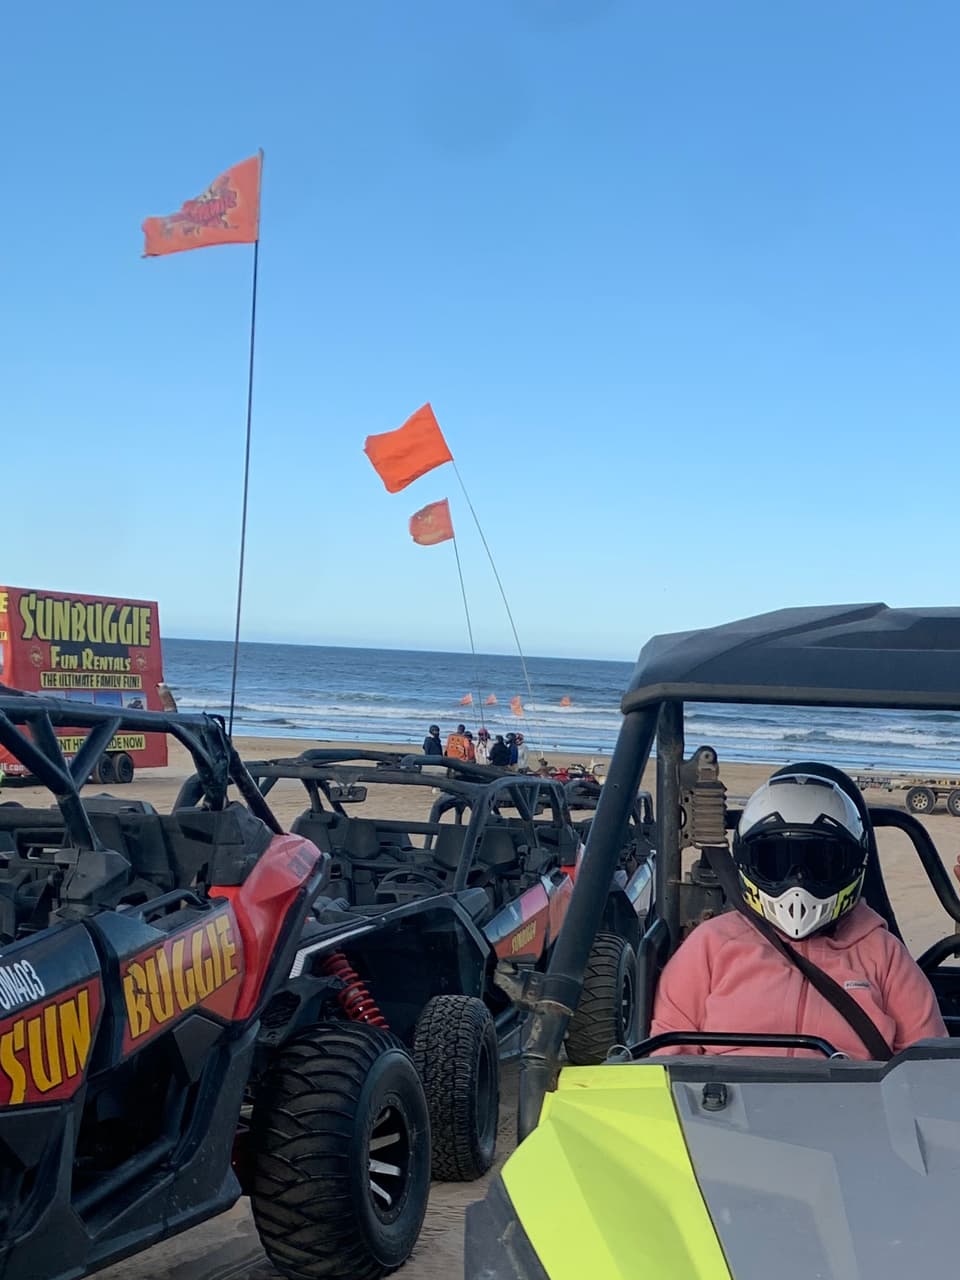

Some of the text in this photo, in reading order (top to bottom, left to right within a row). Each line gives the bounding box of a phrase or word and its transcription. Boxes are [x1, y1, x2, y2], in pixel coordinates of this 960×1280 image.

[19, 593, 151, 647] SUNBUGGIE
[43, 673, 57, 687] THE
[59, 673, 94, 688] ULTIMATE
[96, 674, 122, 688] FAMILY
[58, 738, 71, 751] NT
[123, 737, 144, 748] NOW
[0, 914, 240, 1105] SUN BUGGIE
